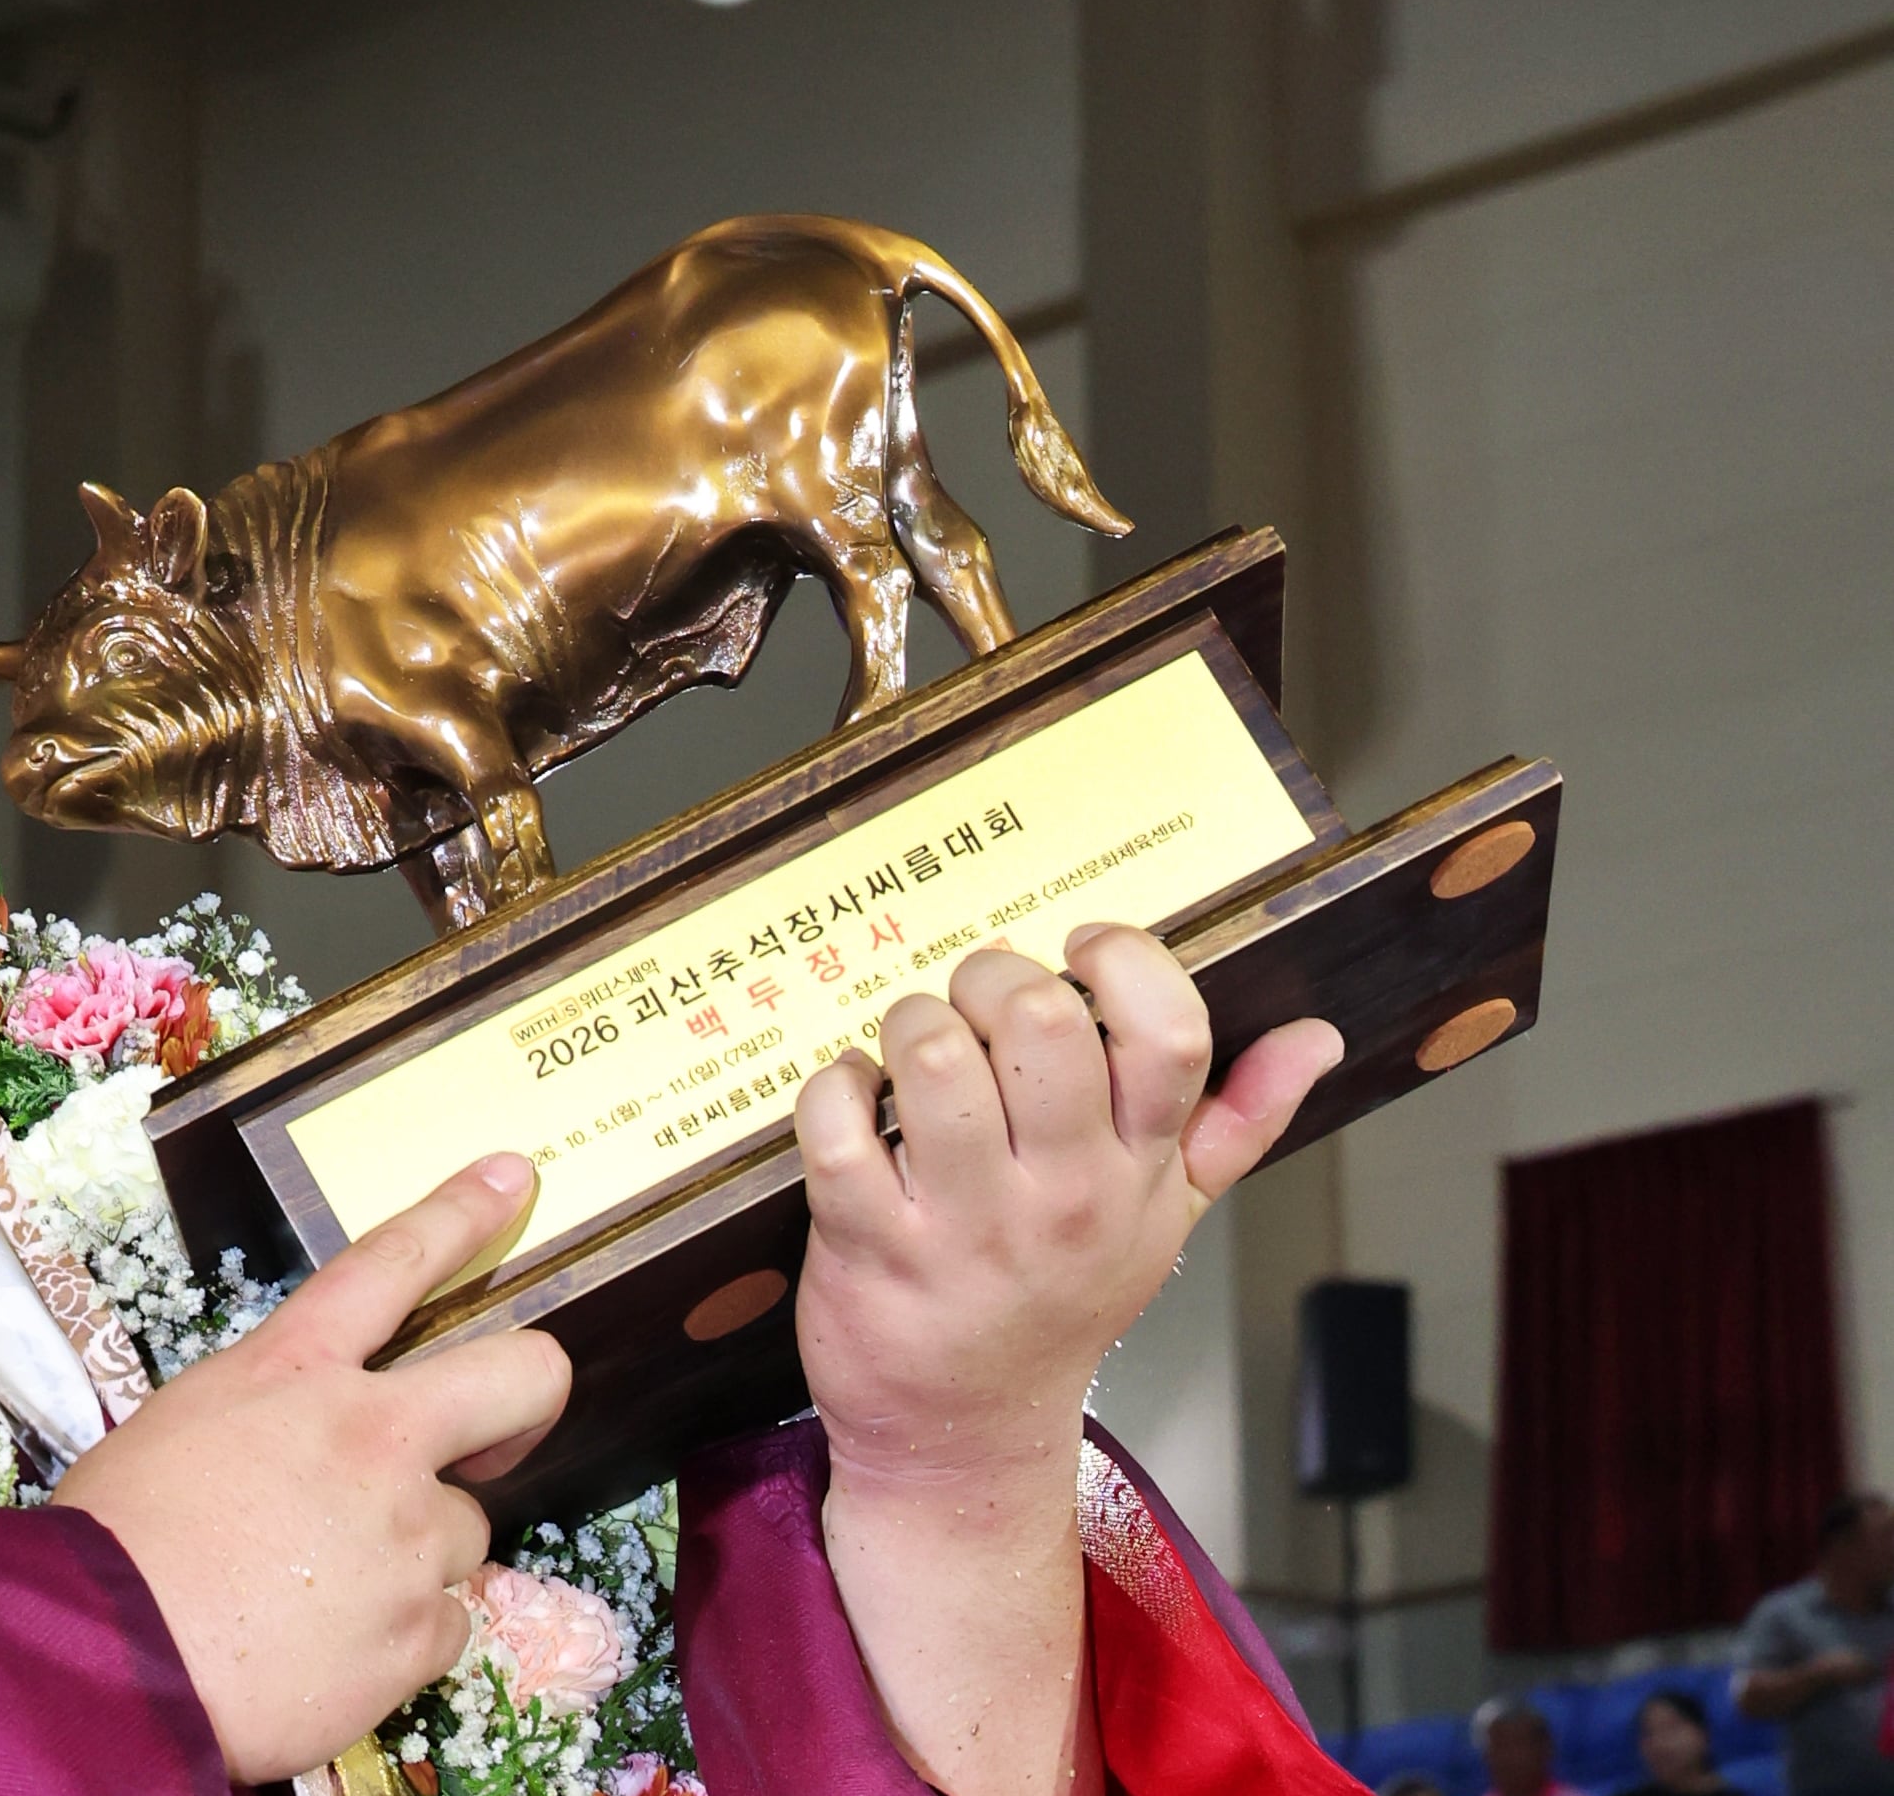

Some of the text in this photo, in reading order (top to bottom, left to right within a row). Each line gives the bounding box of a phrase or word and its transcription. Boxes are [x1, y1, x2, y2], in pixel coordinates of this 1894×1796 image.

[527, 801, 1025, 1079] 2026 괴산추석장사씨름대회
[910, 923, 981, 970] 충청북도
[986, 893, 1041, 930] 괴산군
[579, 958, 661, 1009] 위더스제약
[654, 1061, 802, 1149] 대한씨름협회
